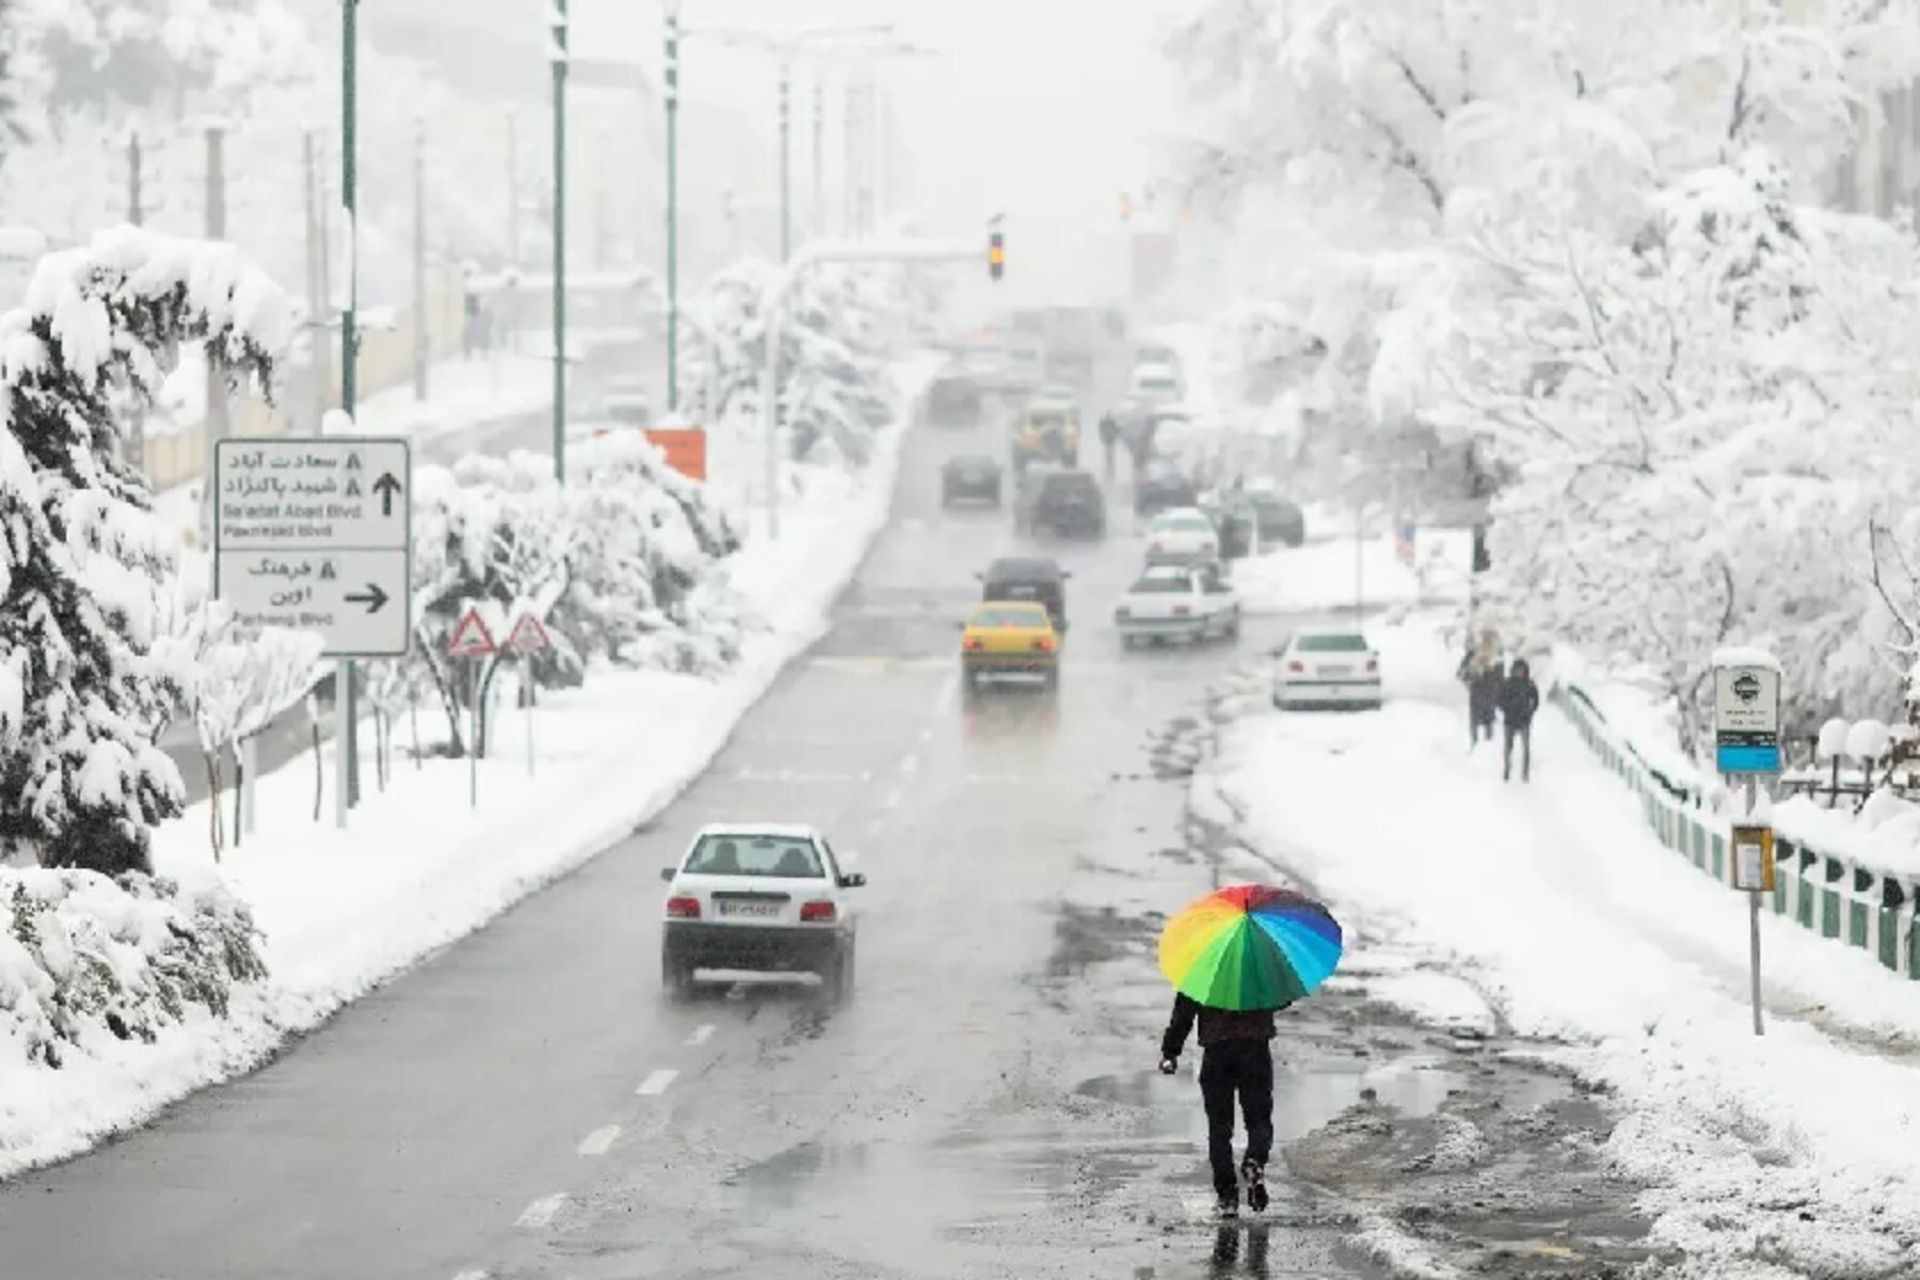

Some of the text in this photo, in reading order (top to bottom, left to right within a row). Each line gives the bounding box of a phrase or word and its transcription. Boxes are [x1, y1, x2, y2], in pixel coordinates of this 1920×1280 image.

[229, 451, 338, 470] سعادت آباد
[291, 477, 338, 494] شهید
[247, 558, 312, 580] فرهنگ
[270, 586, 312, 607] اوین
